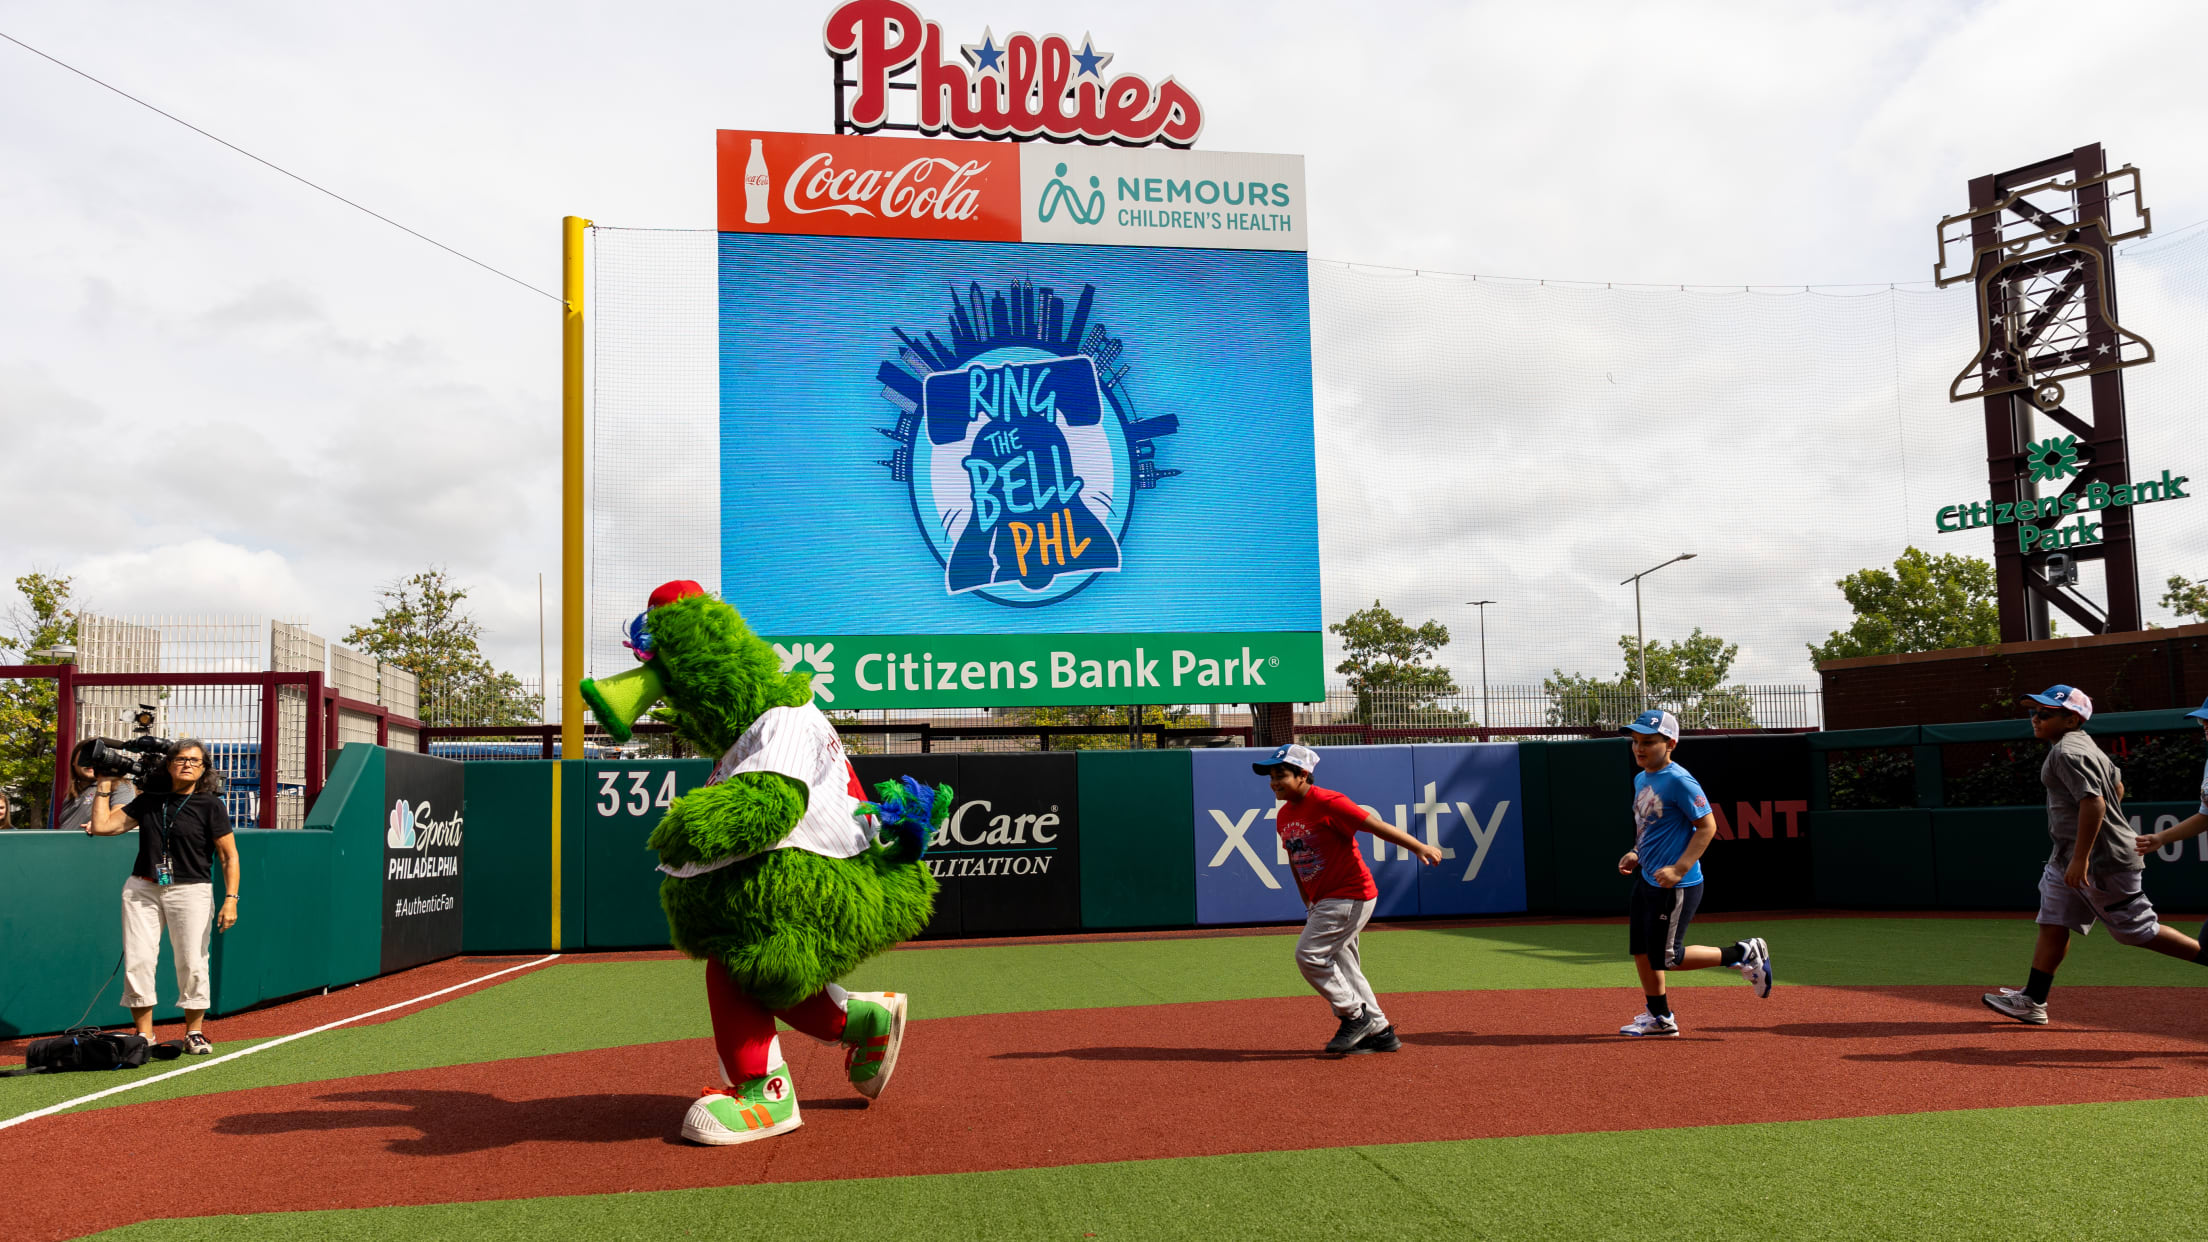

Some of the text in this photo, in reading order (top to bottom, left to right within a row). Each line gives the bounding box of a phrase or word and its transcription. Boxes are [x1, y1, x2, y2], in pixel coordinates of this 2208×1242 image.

[823, 0, 1204, 148] Phillies
[784, 152, 992, 220] Coca-Cola
[1117, 176, 1290, 207] NEMOURS
[1118, 209, 1291, 232] CHILDREN'S HEALTH
[969, 367, 1056, 423] RING
[983, 427, 1023, 457] THE
[966, 444, 1082, 533] BELL
[1936, 469, 2187, 533] Citizens Bank
[1008, 508, 1091, 577] PHL
[2018, 516, 2103, 553] Park
[855, 652, 1038, 691] Citizens
[1050, 647, 1160, 689] Bank
[597, 770, 677, 817] 334
[414, 800, 464, 859] Sports
[1710, 800, 1808, 840] ANT
[388, 856, 458, 880] PHILADELPHIA
[395, 893, 454, 917] #AuthenticFan
[767, 1077, 783, 1100] P
